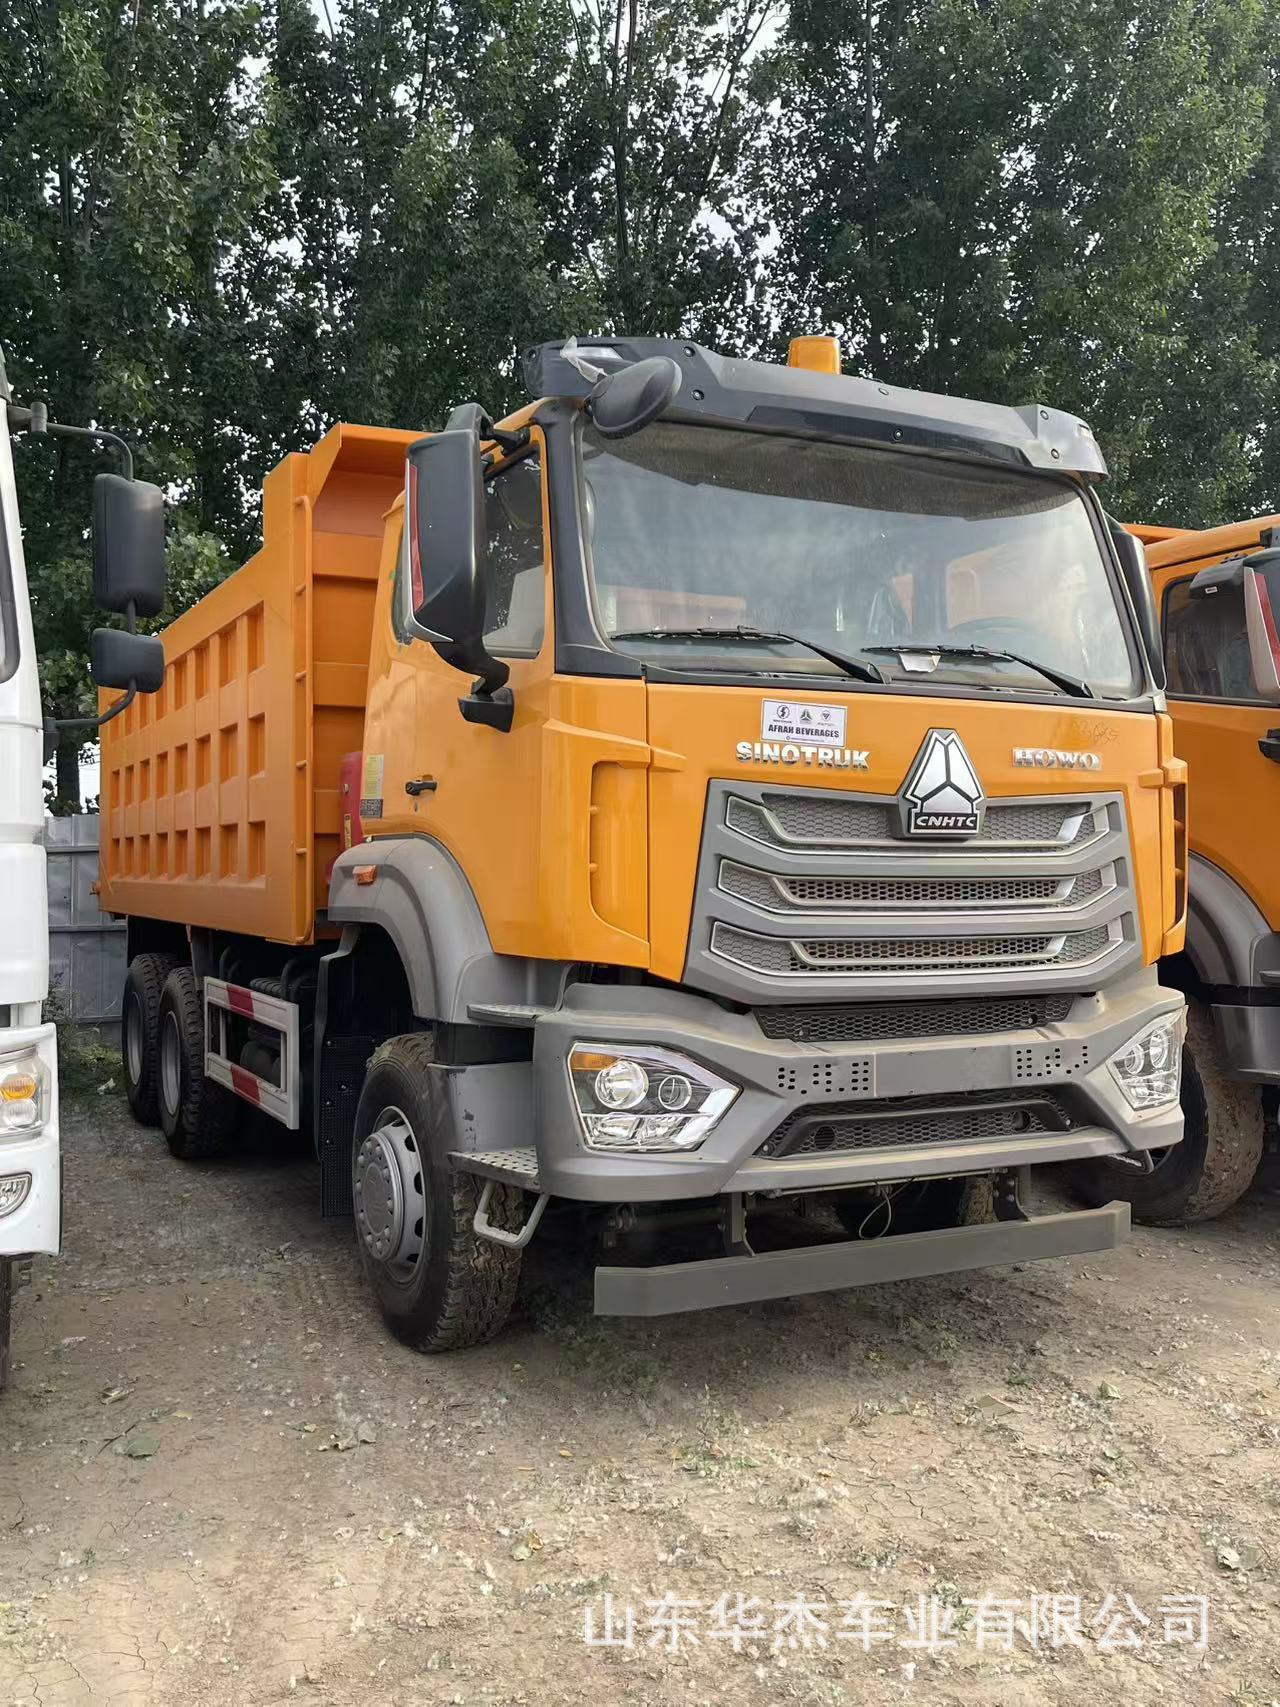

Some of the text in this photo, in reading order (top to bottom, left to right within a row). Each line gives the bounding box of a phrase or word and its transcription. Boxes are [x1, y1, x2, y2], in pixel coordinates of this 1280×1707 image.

[796, 727, 840, 738] BEVERAGES
[736, 741, 870, 769] SINOTRUK
[1013, 747, 1100, 768] HOWO
[916, 815, 976, 829] CNHTC
